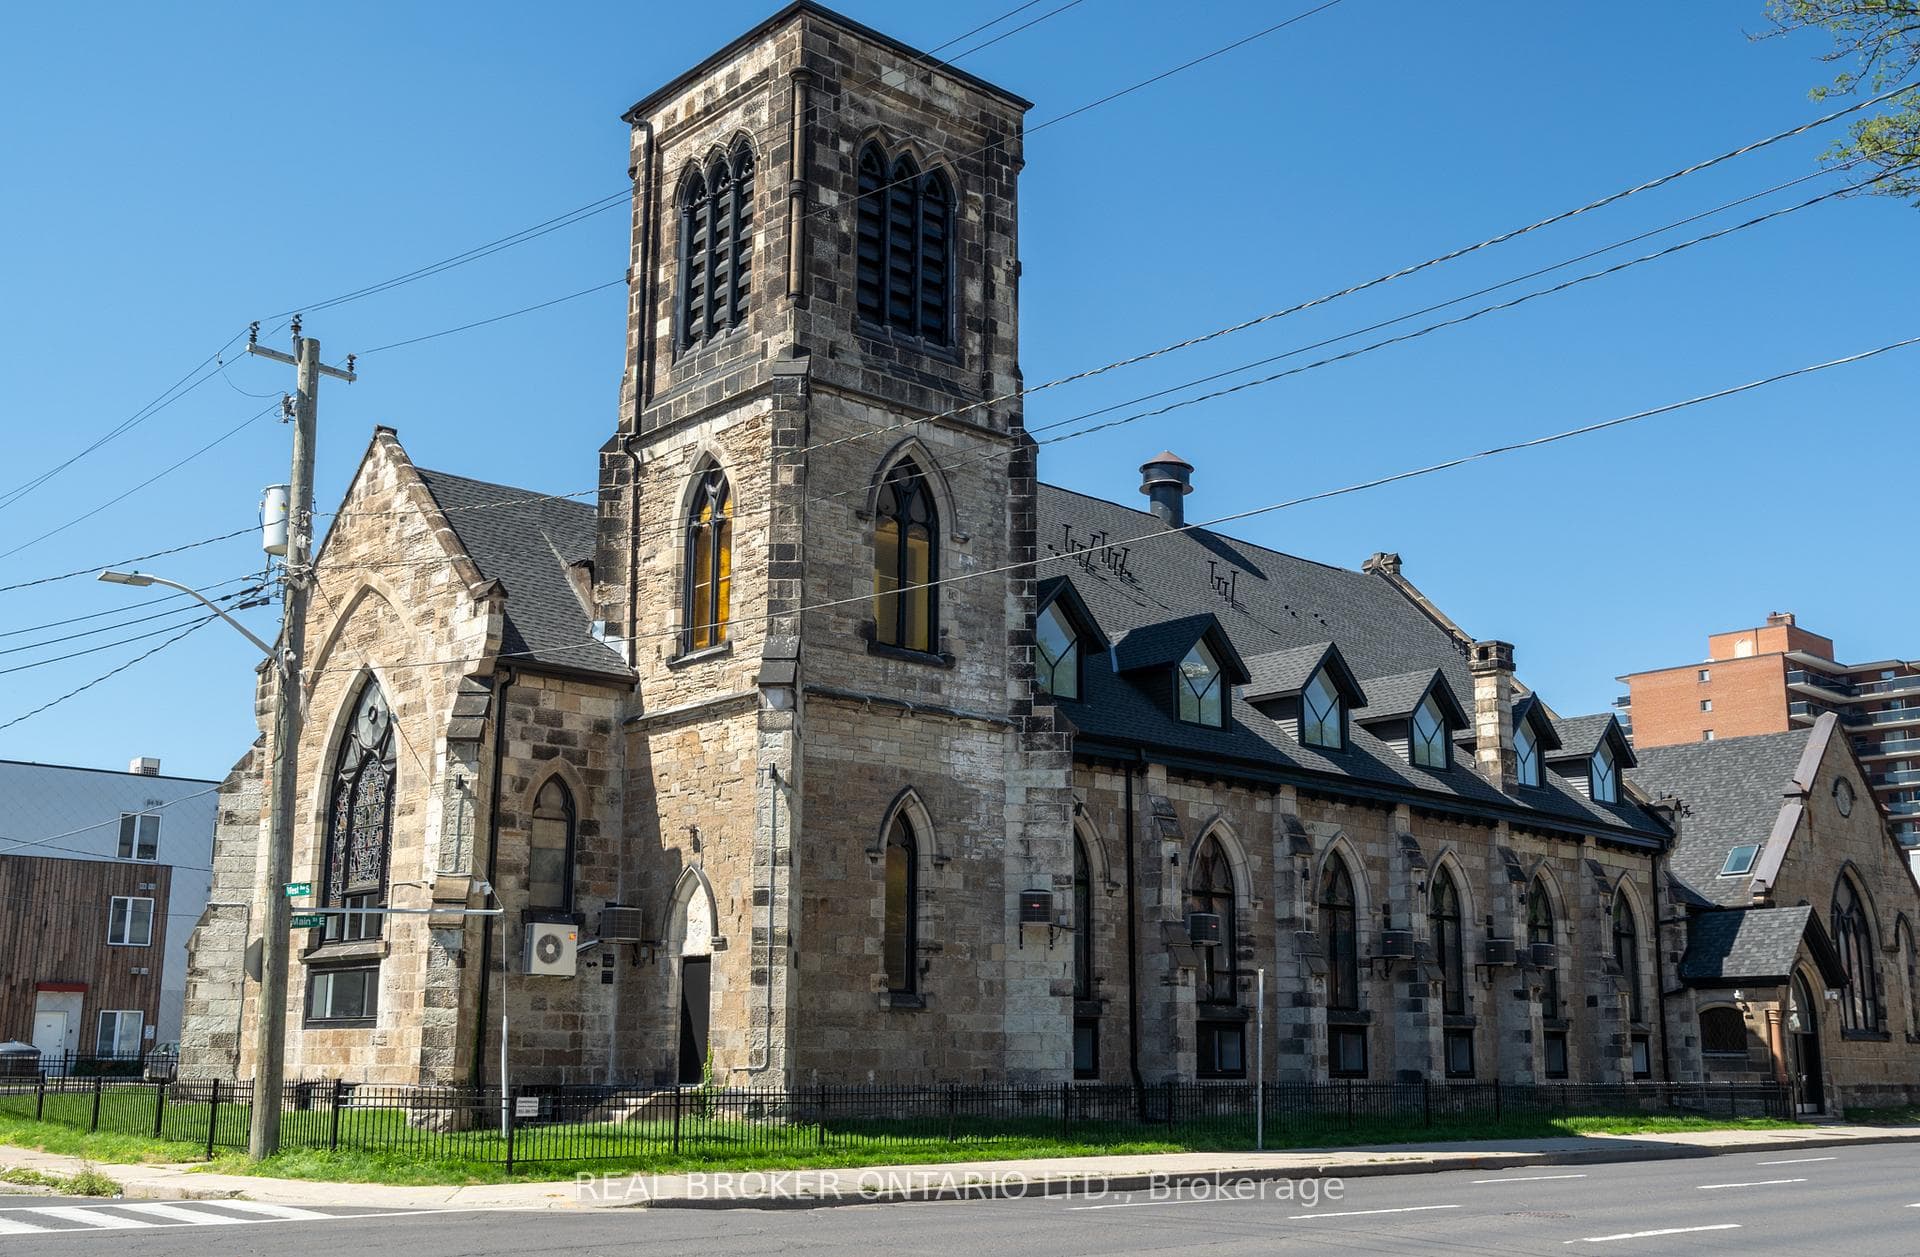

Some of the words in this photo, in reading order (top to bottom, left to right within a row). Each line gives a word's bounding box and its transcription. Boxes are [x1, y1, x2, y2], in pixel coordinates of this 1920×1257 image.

[286, 886, 299, 895] West
[305, 885, 310, 894] S
[292, 917, 311, 926] Main
[319, 917, 325, 926] E
